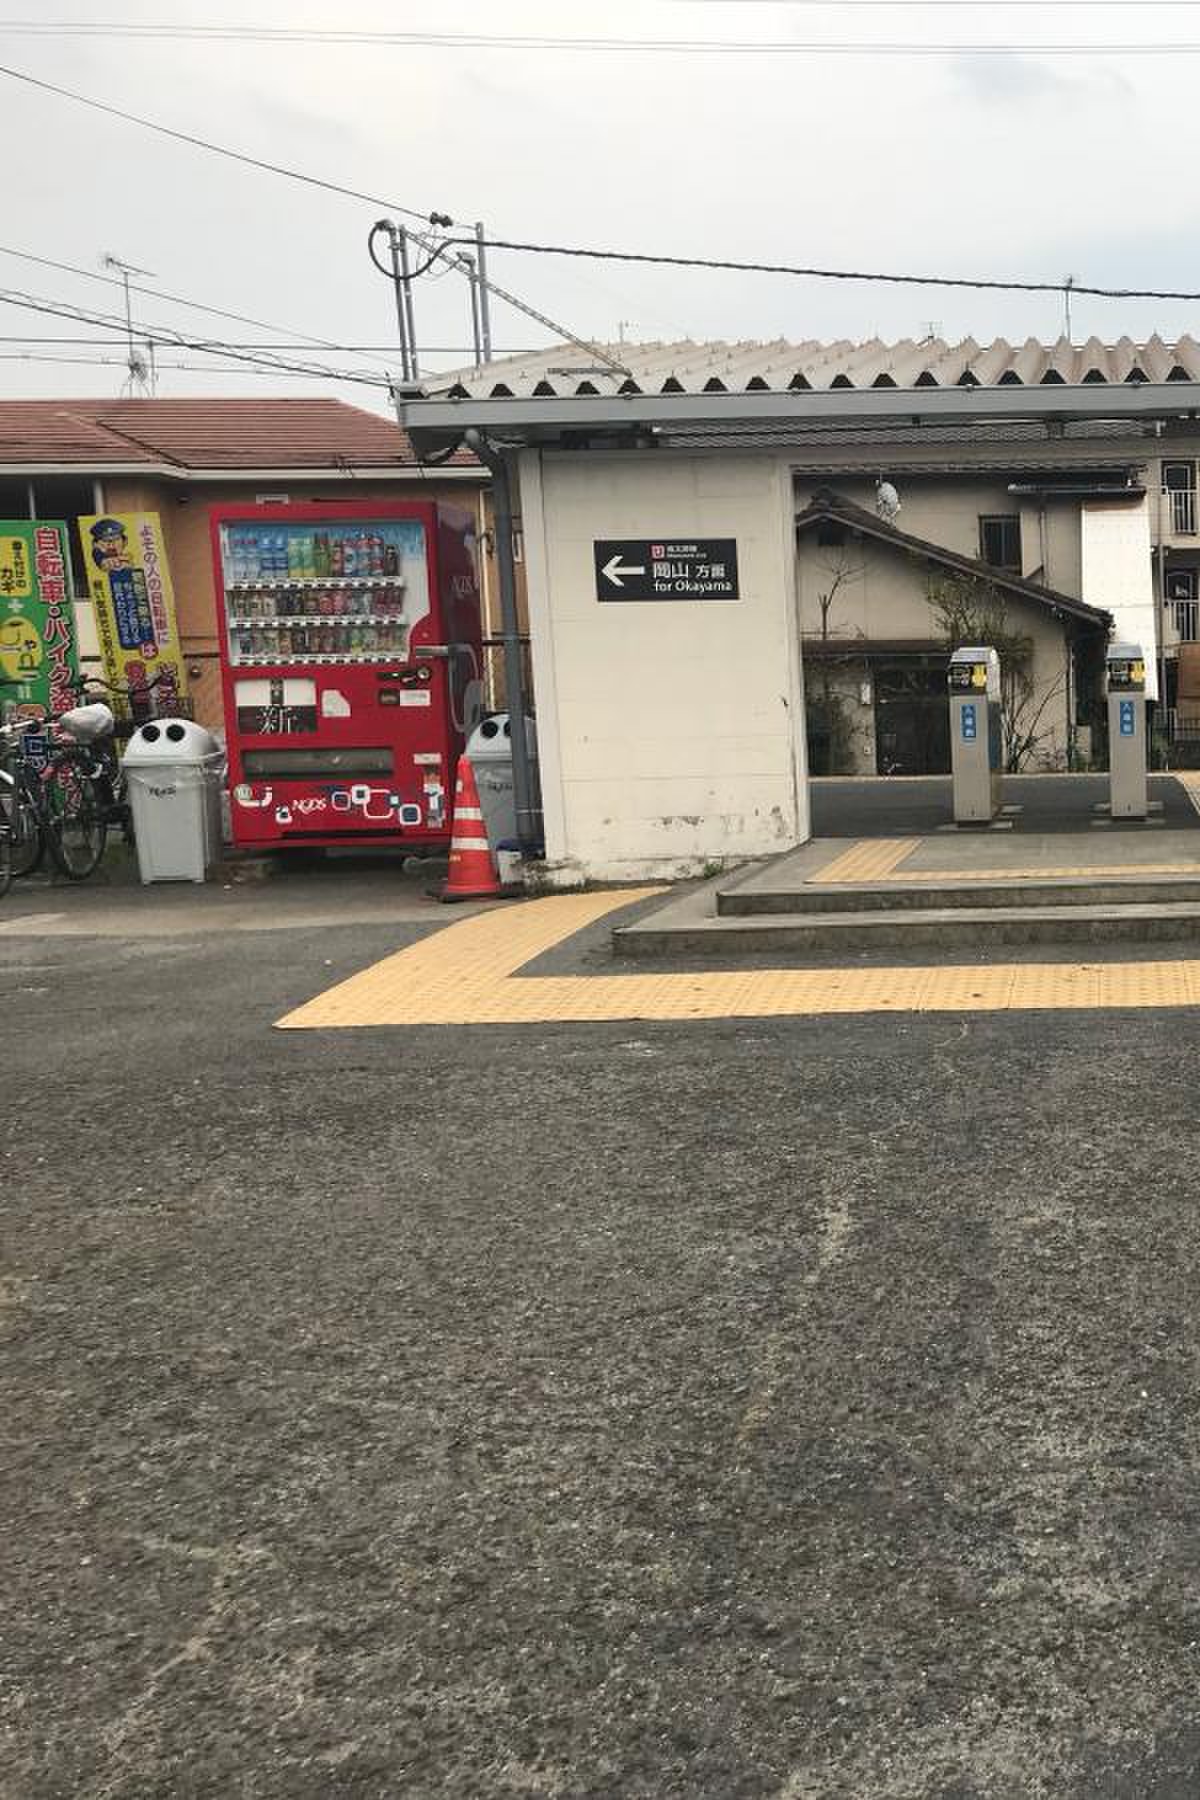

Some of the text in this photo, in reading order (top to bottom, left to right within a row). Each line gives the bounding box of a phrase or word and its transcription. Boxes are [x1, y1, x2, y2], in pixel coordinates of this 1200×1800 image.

[653, 562, 725, 578] 岡山 方面
[654, 579, 733, 593] for Okayama
